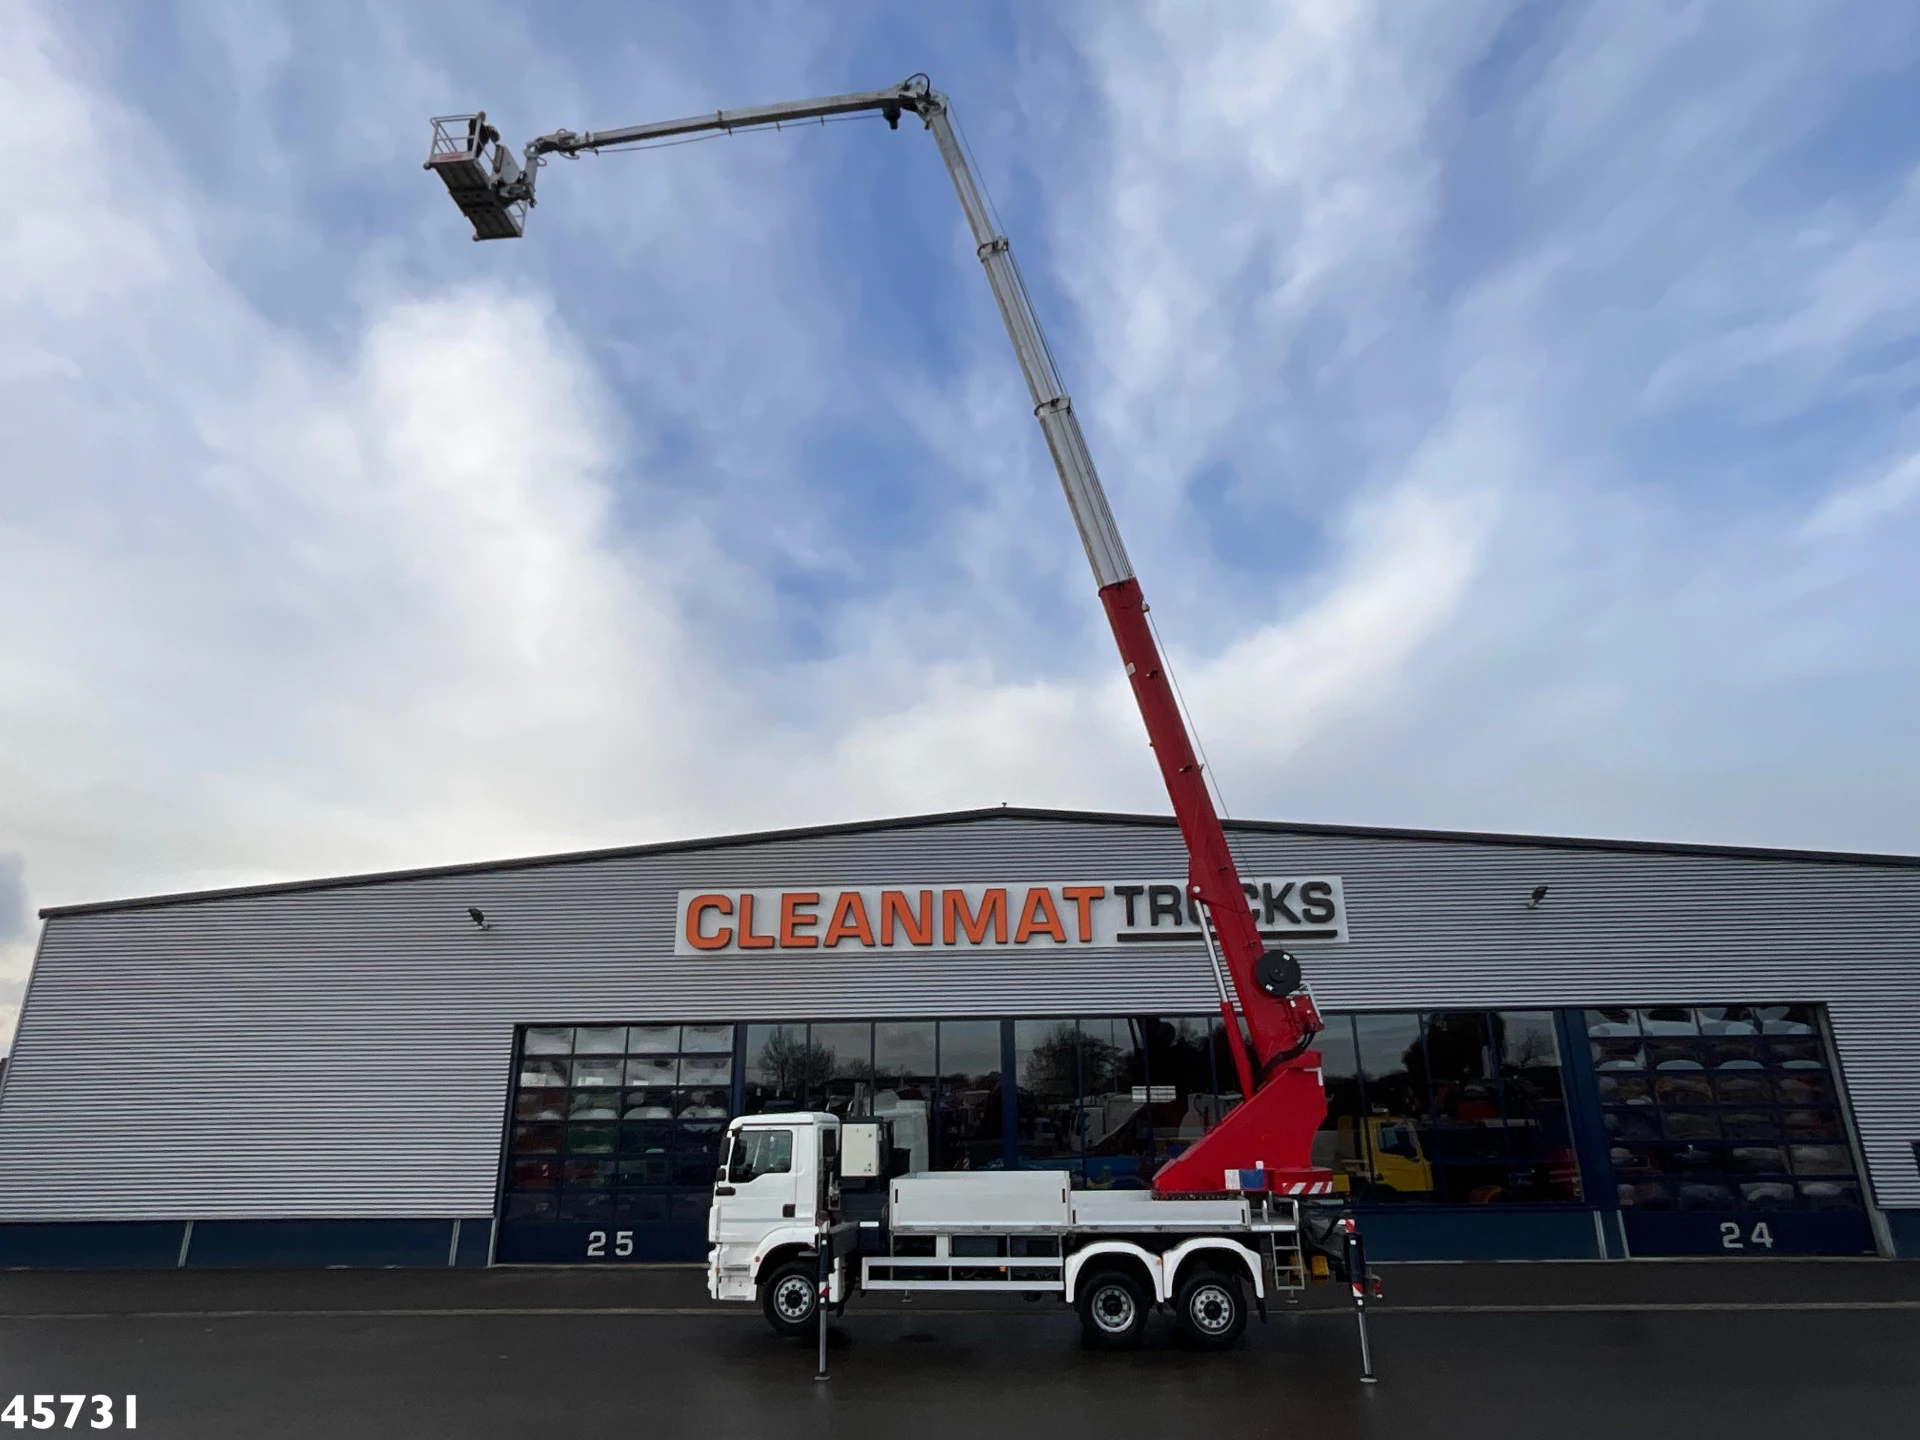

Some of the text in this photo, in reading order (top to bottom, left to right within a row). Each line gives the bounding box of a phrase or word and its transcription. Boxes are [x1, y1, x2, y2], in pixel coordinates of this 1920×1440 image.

[685, 886, 1105, 950] CLEANMAT
[587, 1230, 634, 1256] 25
[1720, 1222, 1774, 1249] 24
